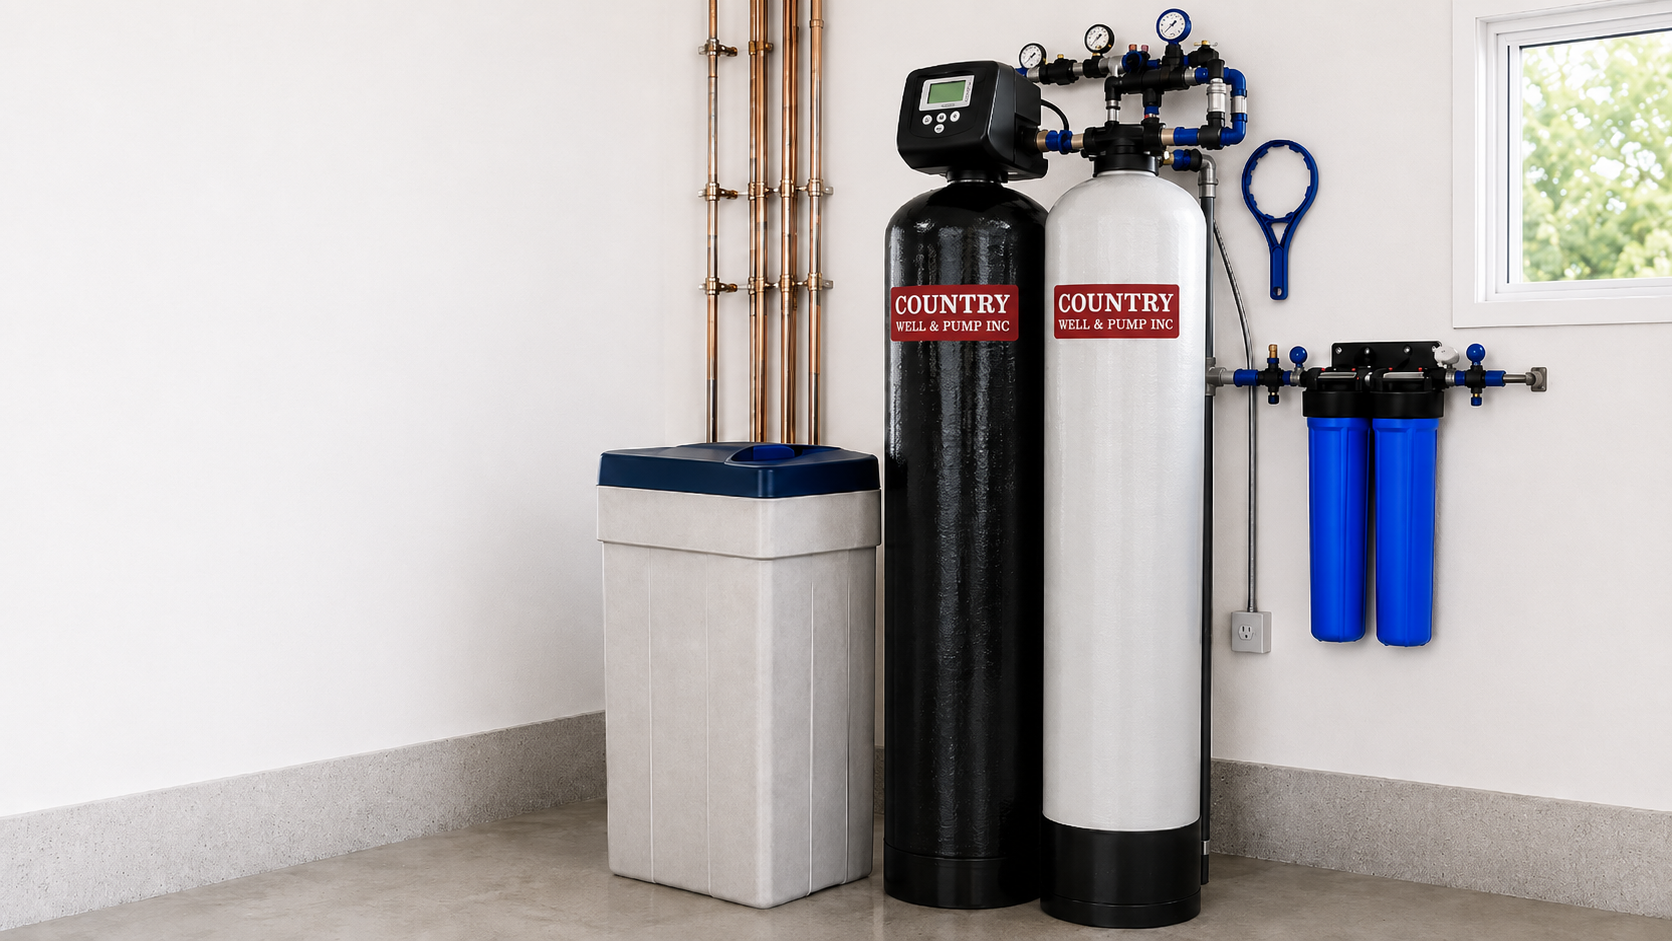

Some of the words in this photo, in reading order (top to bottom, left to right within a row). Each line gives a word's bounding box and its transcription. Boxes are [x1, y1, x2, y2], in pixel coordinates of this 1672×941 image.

[895, 294, 1011, 315] COUNTRY
[1058, 293, 1174, 313] COUNTRY
[896, 320, 927, 332] WELL
[929, 320, 939, 332] &
[942, 320, 982, 332] PUMP
[986, 320, 1010, 332] INC
[1058, 318, 1091, 330] WELL
[1093, 318, 1104, 330] &
[1107, 318, 1147, 330] PUMP
[1150, 318, 1174, 330] INC
